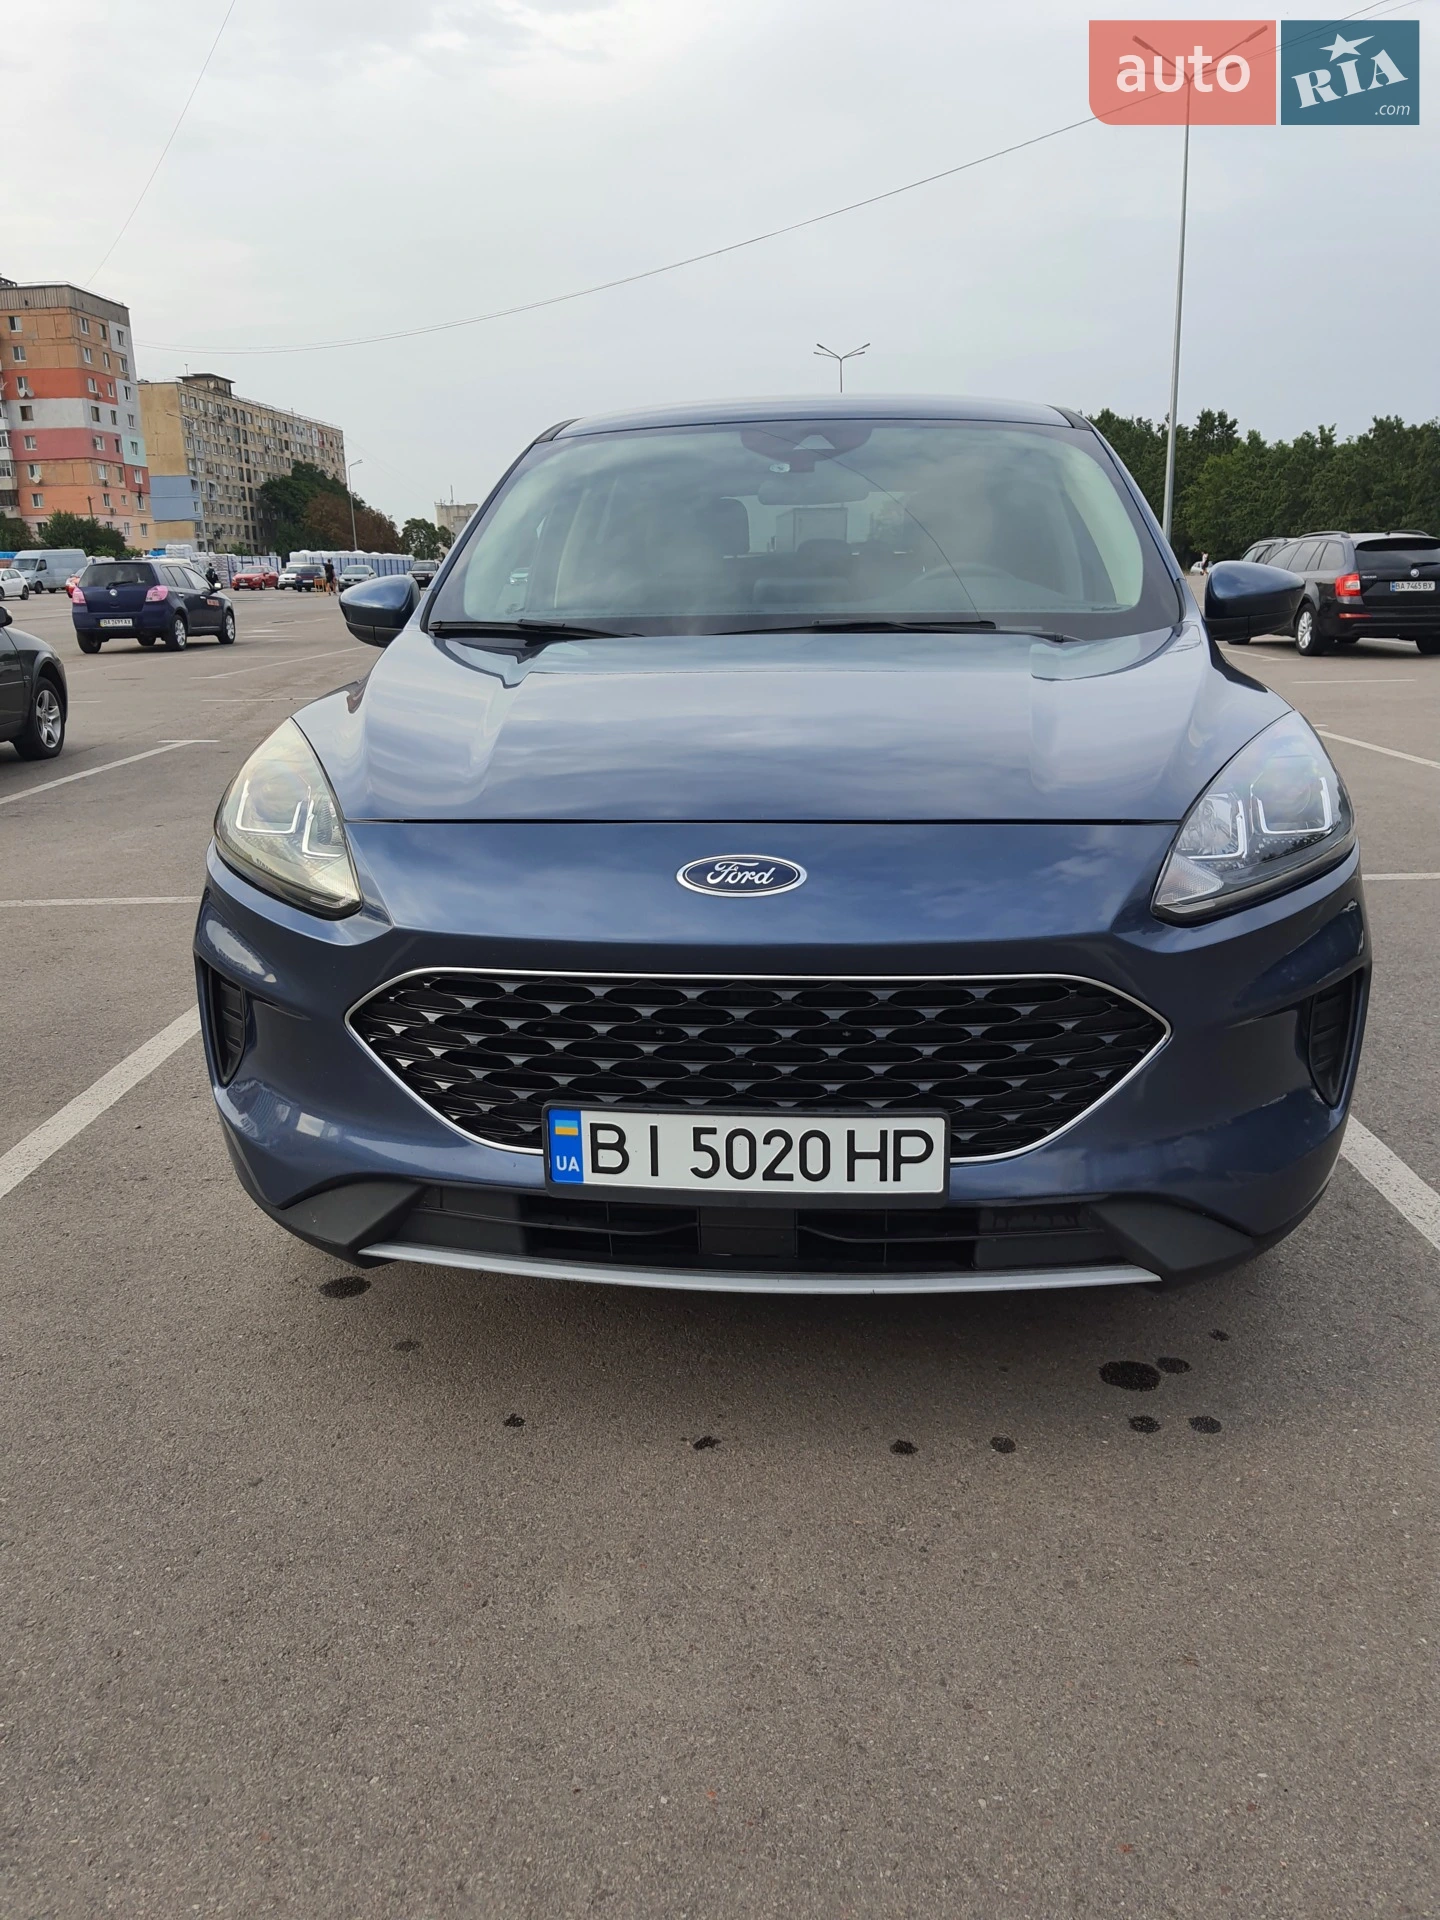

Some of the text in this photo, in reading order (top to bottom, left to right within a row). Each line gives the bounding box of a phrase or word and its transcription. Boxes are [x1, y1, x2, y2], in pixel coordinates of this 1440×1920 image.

[1395, 582, 1405, 590] BA
[706, 860, 776, 885] Ford
[589, 1122, 935, 1183] BI 5020 HP
[556, 1155, 580, 1172] UA
